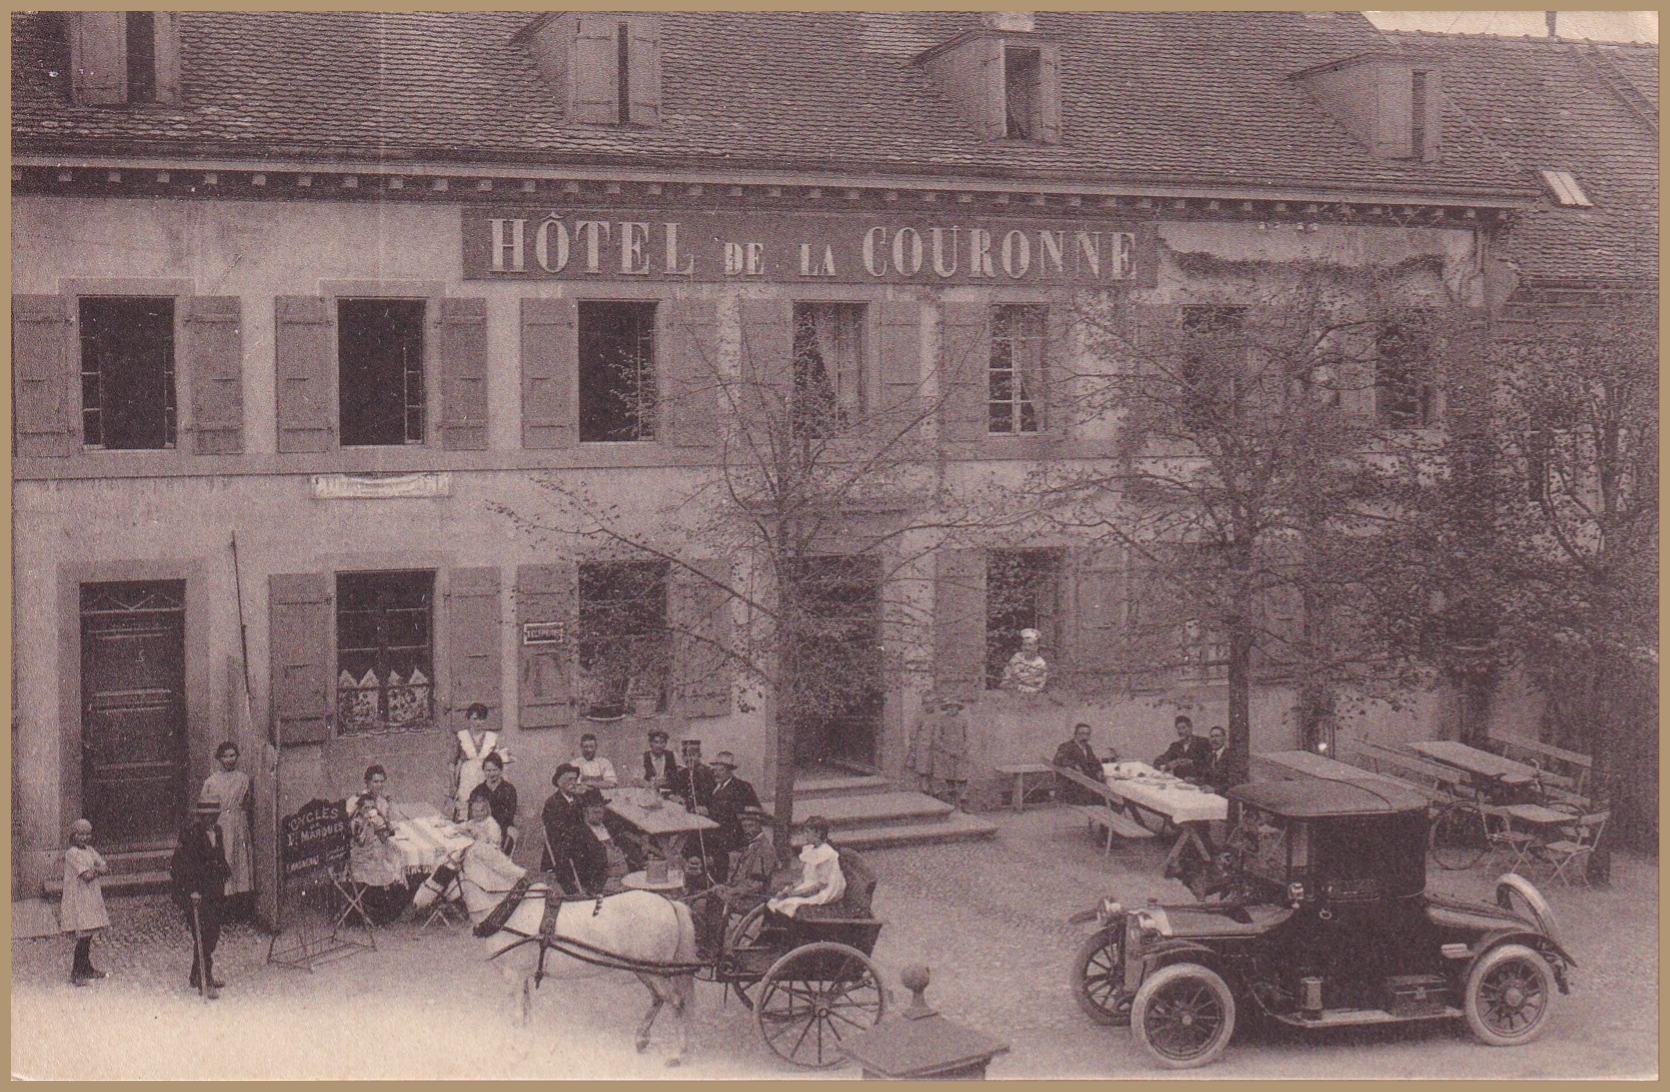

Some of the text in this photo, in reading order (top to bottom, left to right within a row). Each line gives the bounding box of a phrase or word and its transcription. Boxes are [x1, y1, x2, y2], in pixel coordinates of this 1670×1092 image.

[488, 211, 1137, 281] HÔTEL DE LA COURONNE
[289, 807, 339, 831] CYCLES
